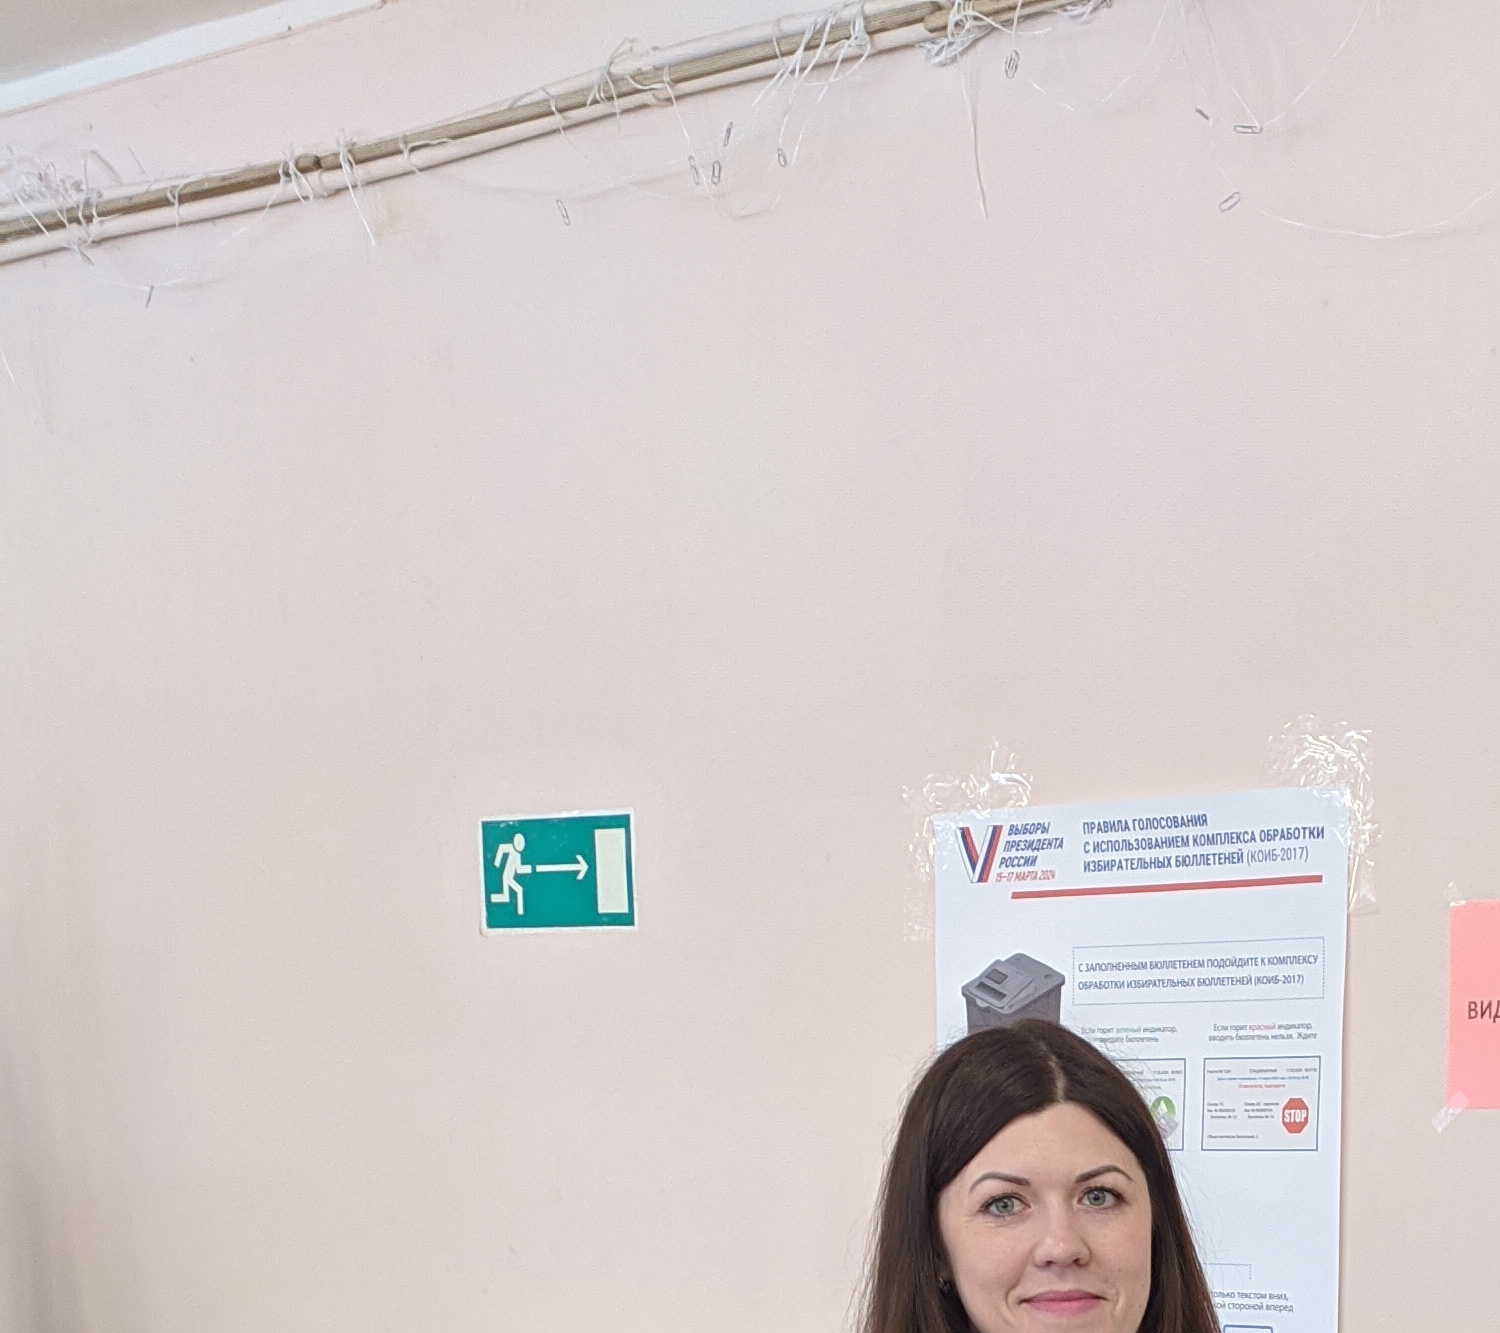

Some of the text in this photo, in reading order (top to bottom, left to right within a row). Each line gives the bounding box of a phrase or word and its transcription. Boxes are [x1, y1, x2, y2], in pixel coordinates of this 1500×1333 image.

[1008, 821, 1050, 836] ВЫБОРЫ
[1082, 813, 1208, 835] ПРАВИЛА ГОЛОСОВАНИЯ
[1003, 837, 1064, 852] ПРЕЗИДЕНТА
[1083, 826, 1325, 853] С ИСПОЛЬЗОВАНИЕМ КОМПЛЕКСА ОБРАБОТКИ
[999, 855, 1038, 868] РОССИИ
[1083, 846, 1309, 873] ИЗБИРАТЕЛЬНЫХ БЮЛЛЕТЕНЕЙ (КОИБ-2017)
[1078, 954, 1319, 973] С ЗАПОЛНЕННЫМ БЮЛЛЕТЕНЕМ ПОДОЙДИТЕ К КОМПЛЕКСУ
[1078, 974, 1304, 991] ОБРАБОТКИ ИЗБИРАТЕЛЬНЫХ БЮЛЛЕТЕНЕЙ (КОИБ-2017)
[1284, 1109, 1307, 1122] STOP
[1228, 1301, 1264, 1311] стороной
[1265, 1303, 1294, 1313] вперед
